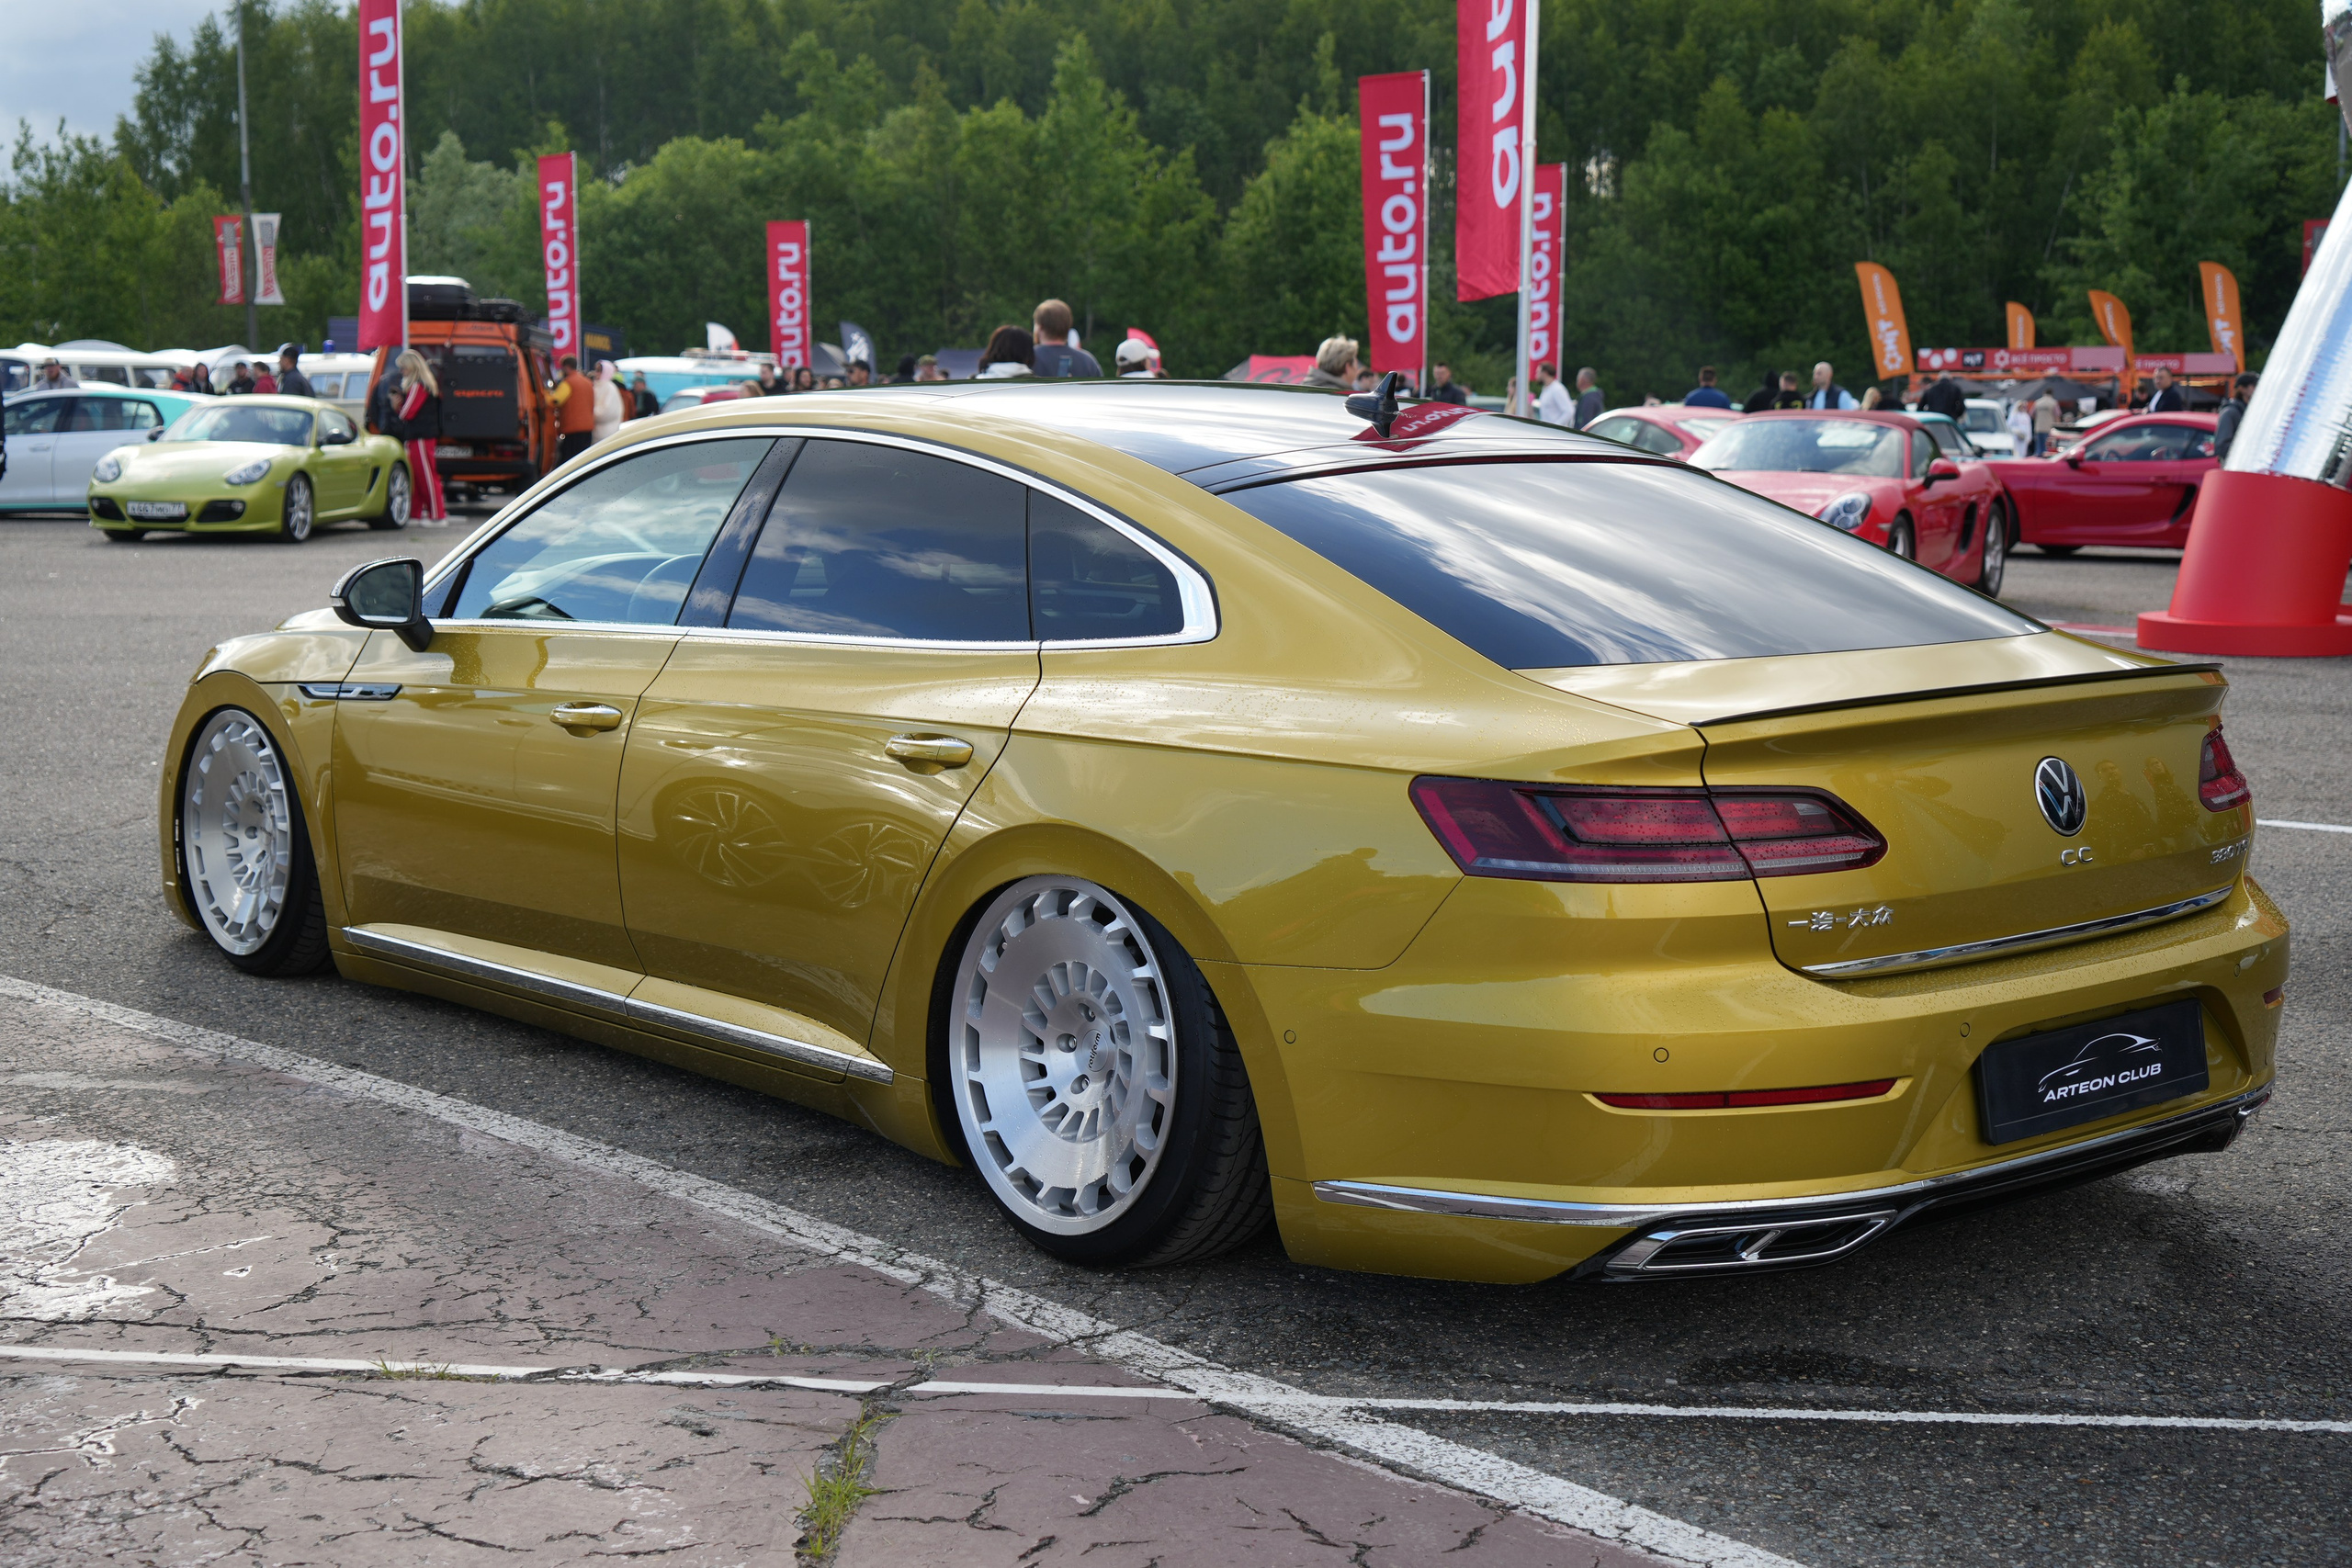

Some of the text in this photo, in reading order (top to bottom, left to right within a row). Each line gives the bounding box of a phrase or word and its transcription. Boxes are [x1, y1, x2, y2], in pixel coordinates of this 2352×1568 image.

[365, 16, 399, 313] auto.ru
[1487, 0, 1521, 209] aut
[546, 180, 571, 349] auto.ru
[1376, 112, 1417, 344] auto.ru
[776, 242, 804, 368] auto.ru
[2060, 846, 2093, 867] CC
[2210, 845, 2234, 864] 380
[1088, 1032, 1102, 1069] rotiform
[2043, 1063, 2163, 1103] ARTEON CLUB
